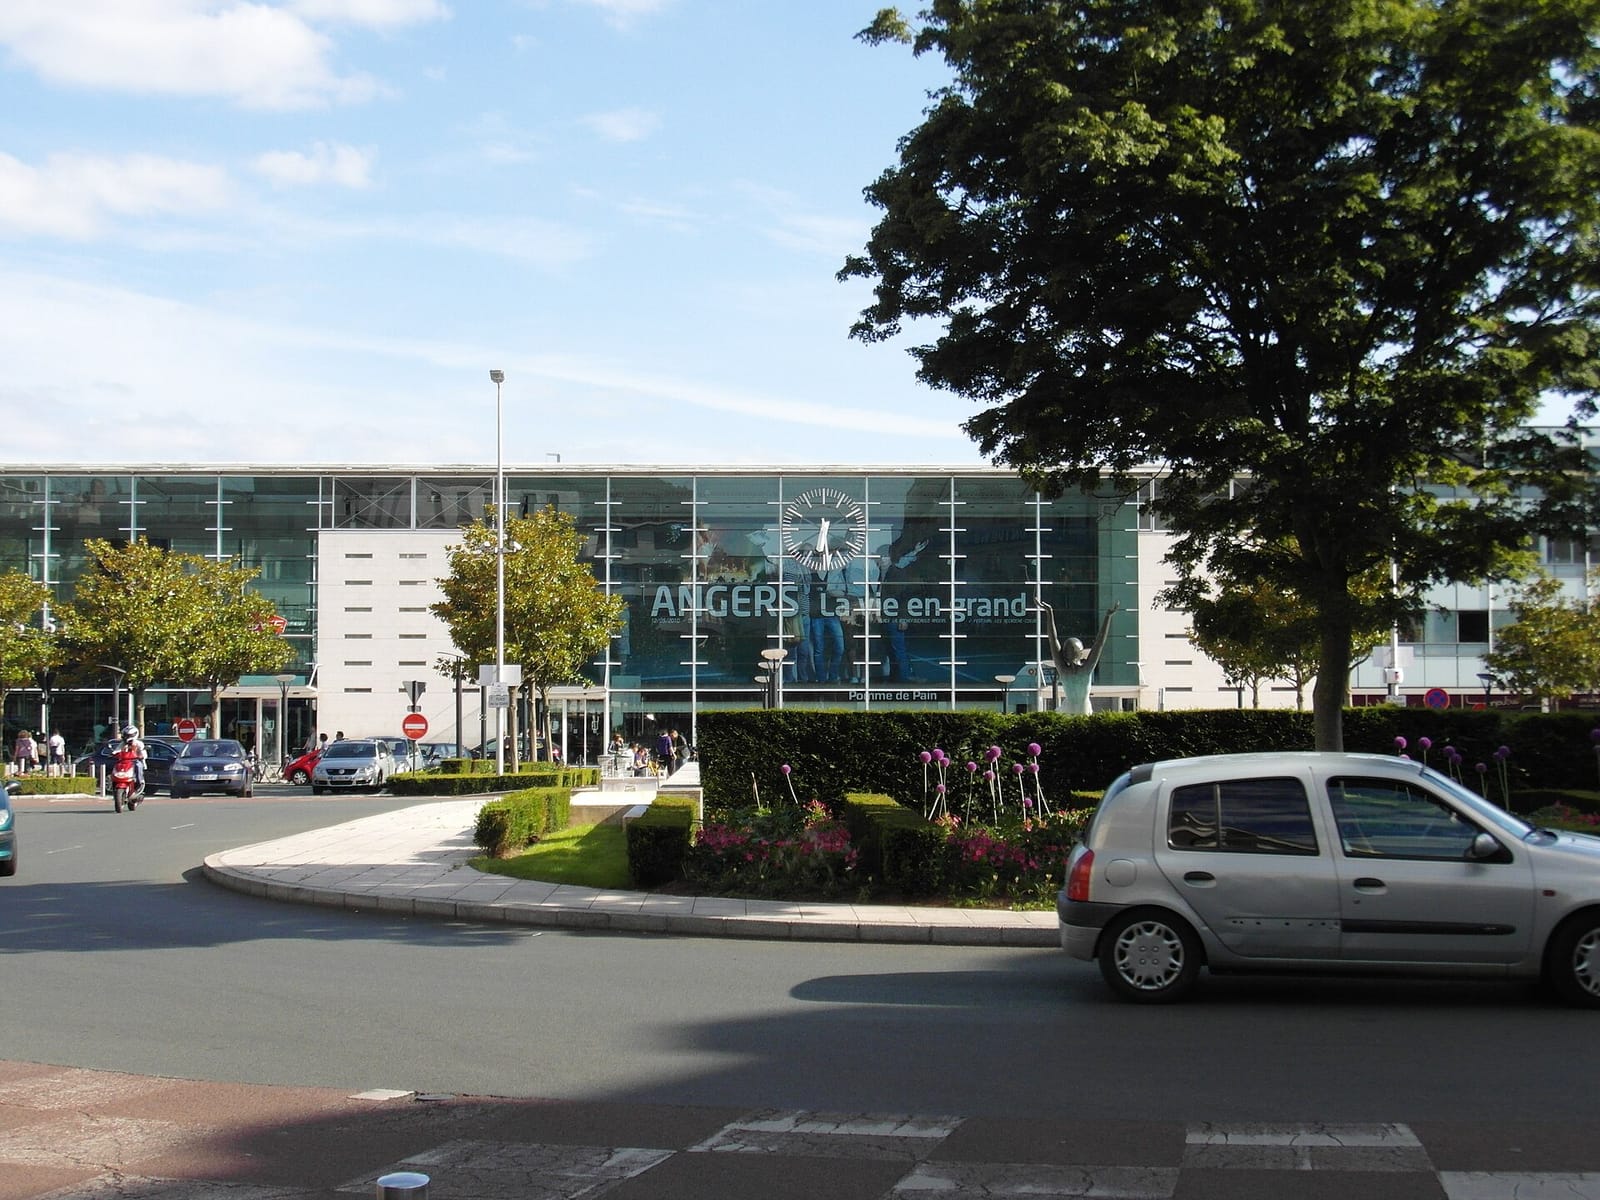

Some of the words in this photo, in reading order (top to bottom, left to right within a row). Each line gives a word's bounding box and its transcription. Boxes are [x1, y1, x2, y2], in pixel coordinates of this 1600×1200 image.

[651, 585, 799, 618] ANGERS
[820, 592, 850, 617] La
[858, 592, 899, 617] vie
[907, 597, 941, 617] en
[950, 592, 1027, 623] grand
[848, 691, 893, 701] Pomme
[895, 691, 910, 701] de
[912, 691, 937, 701] Pain
